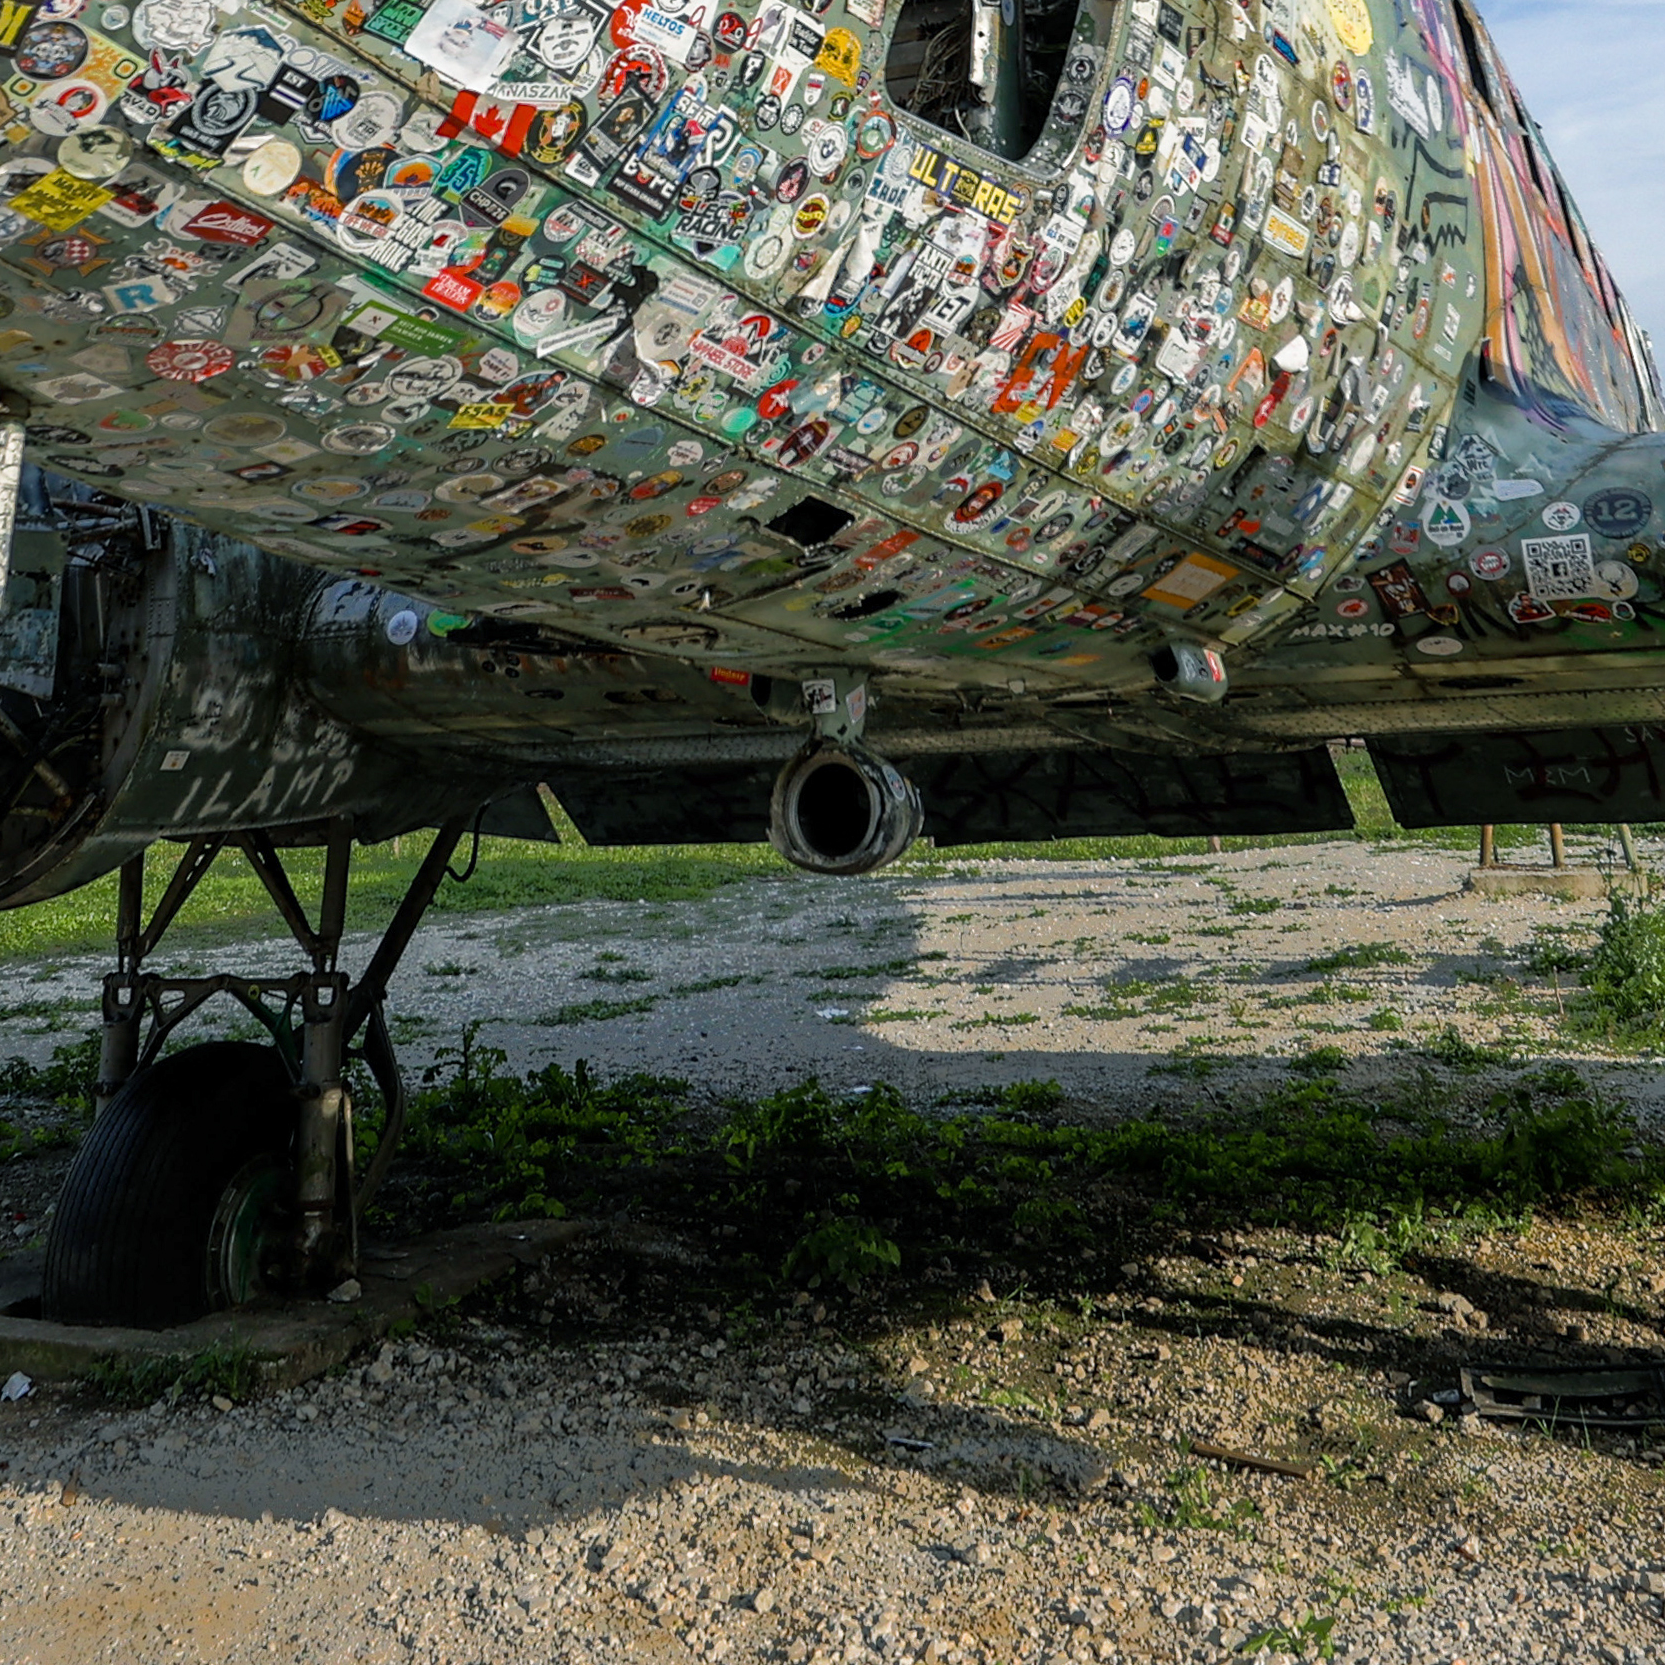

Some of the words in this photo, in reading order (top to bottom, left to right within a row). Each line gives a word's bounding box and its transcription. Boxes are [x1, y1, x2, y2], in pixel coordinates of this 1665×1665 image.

[641, 7, 687, 37] HELTOS
[676, 215, 746, 242] RACING
[1595, 498, 1639, 521] 12
